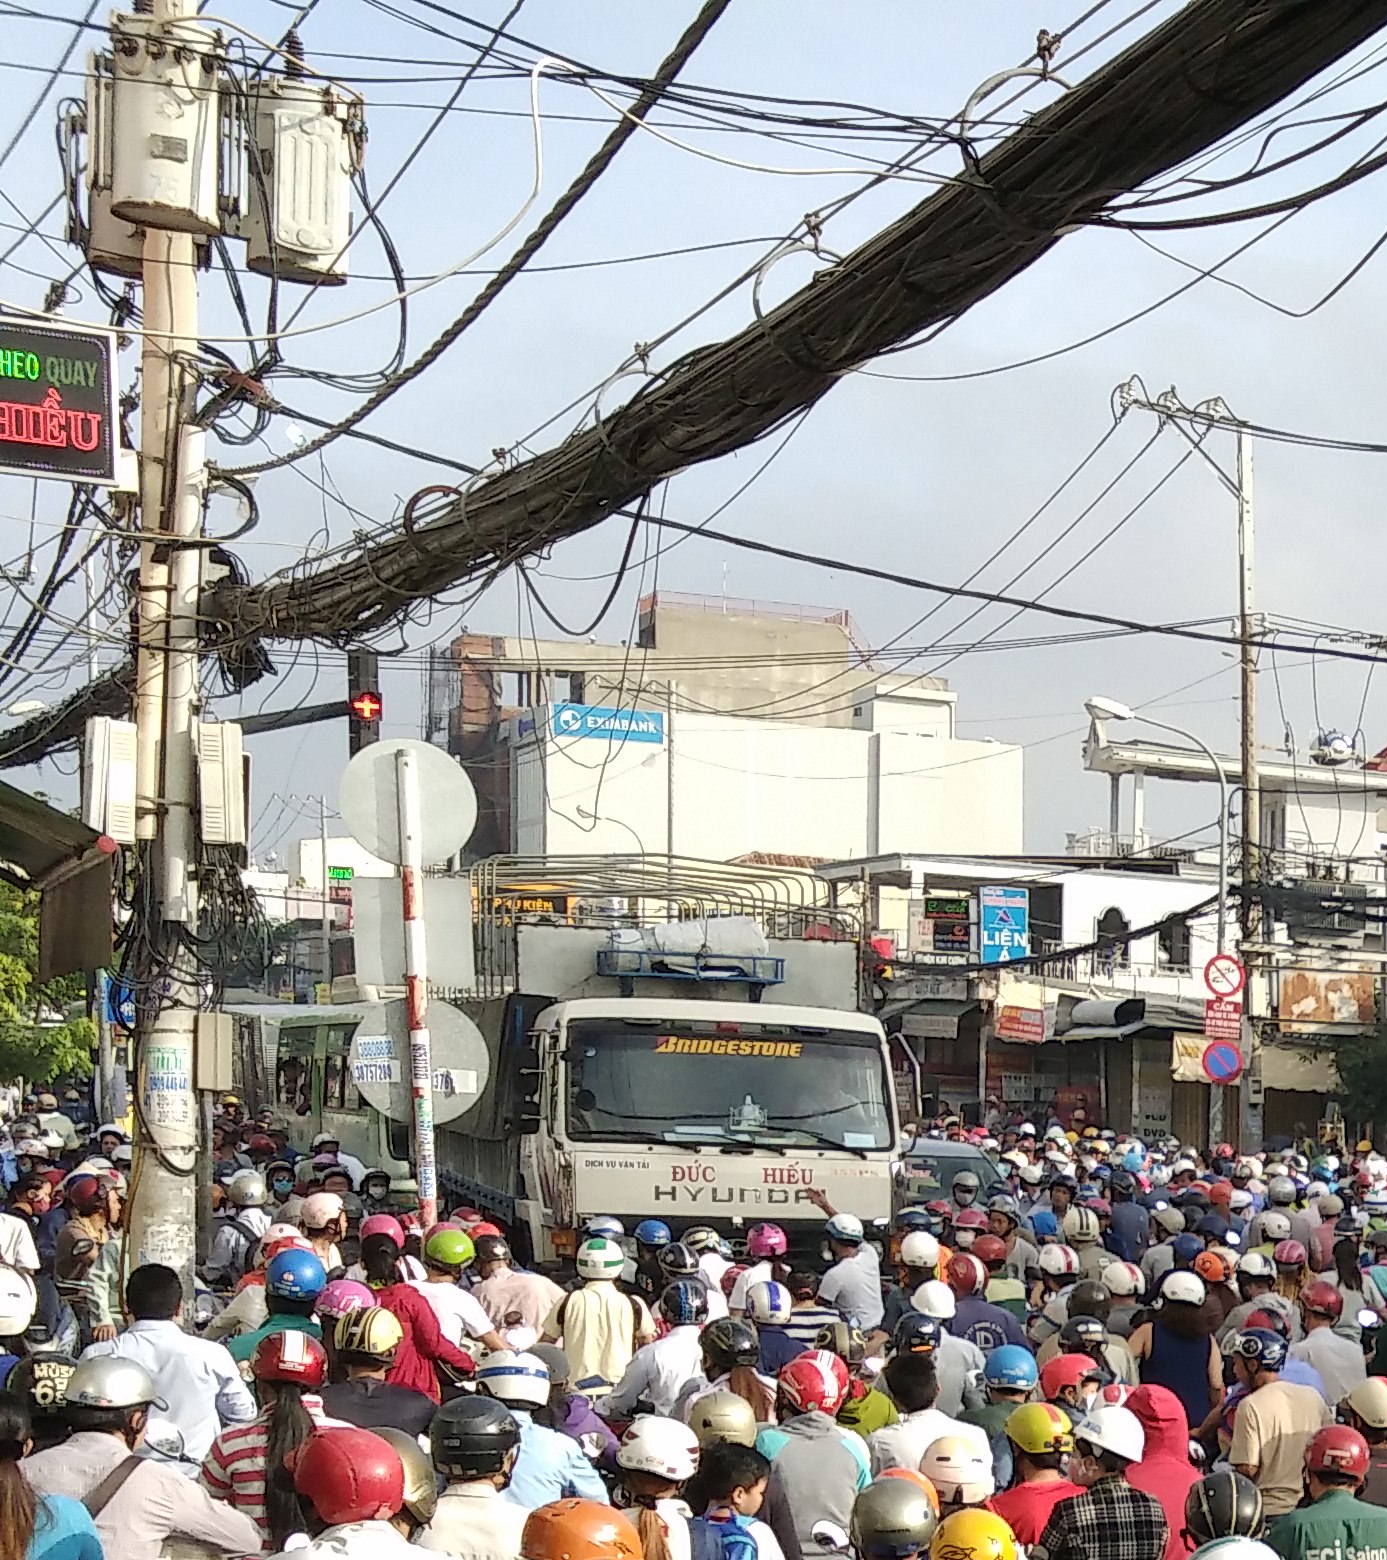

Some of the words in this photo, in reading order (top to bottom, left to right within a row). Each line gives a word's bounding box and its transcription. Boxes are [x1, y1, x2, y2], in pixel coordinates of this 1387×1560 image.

[46, 356, 98, 388] QUAY
[587, 716, 658, 733] EXIMBANK
[983, 927, 1026, 948] LIÊN
[656, 1036, 803, 1058] BRIDGESTONE
[1144, 1128, 1166, 1137] DVD
[585, 1159, 603, 1169] DỊCH
[672, 1160, 716, 1183] ĐỨC
[763, 1160, 814, 1184] HIẾU
